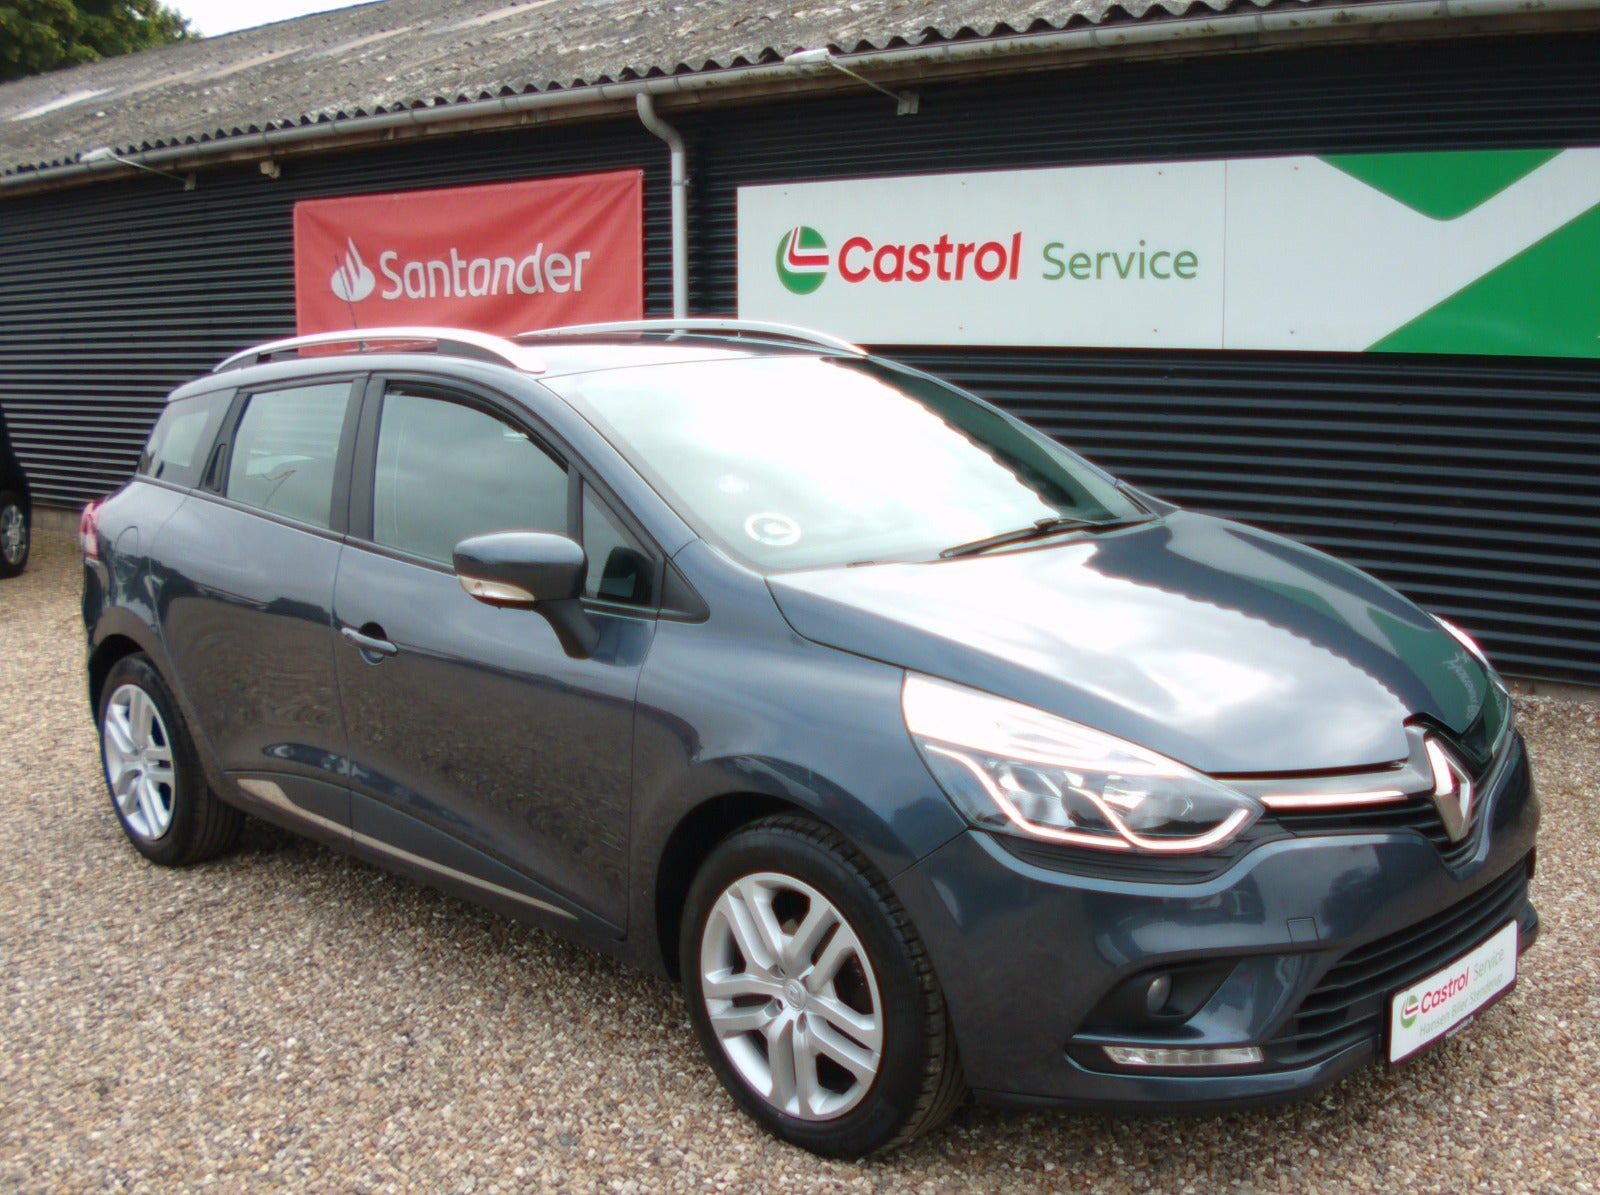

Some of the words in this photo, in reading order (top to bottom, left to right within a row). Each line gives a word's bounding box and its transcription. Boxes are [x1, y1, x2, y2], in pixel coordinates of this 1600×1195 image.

[379, 242, 591, 300] Santander
[837, 231, 1022, 284] Castrol
[1042, 239, 1199, 281] Service
[1420, 966, 1470, 1014] Castrol
[1473, 948, 1505, 981] Service
[1420, 1011, 1450, 1036] Hansen
